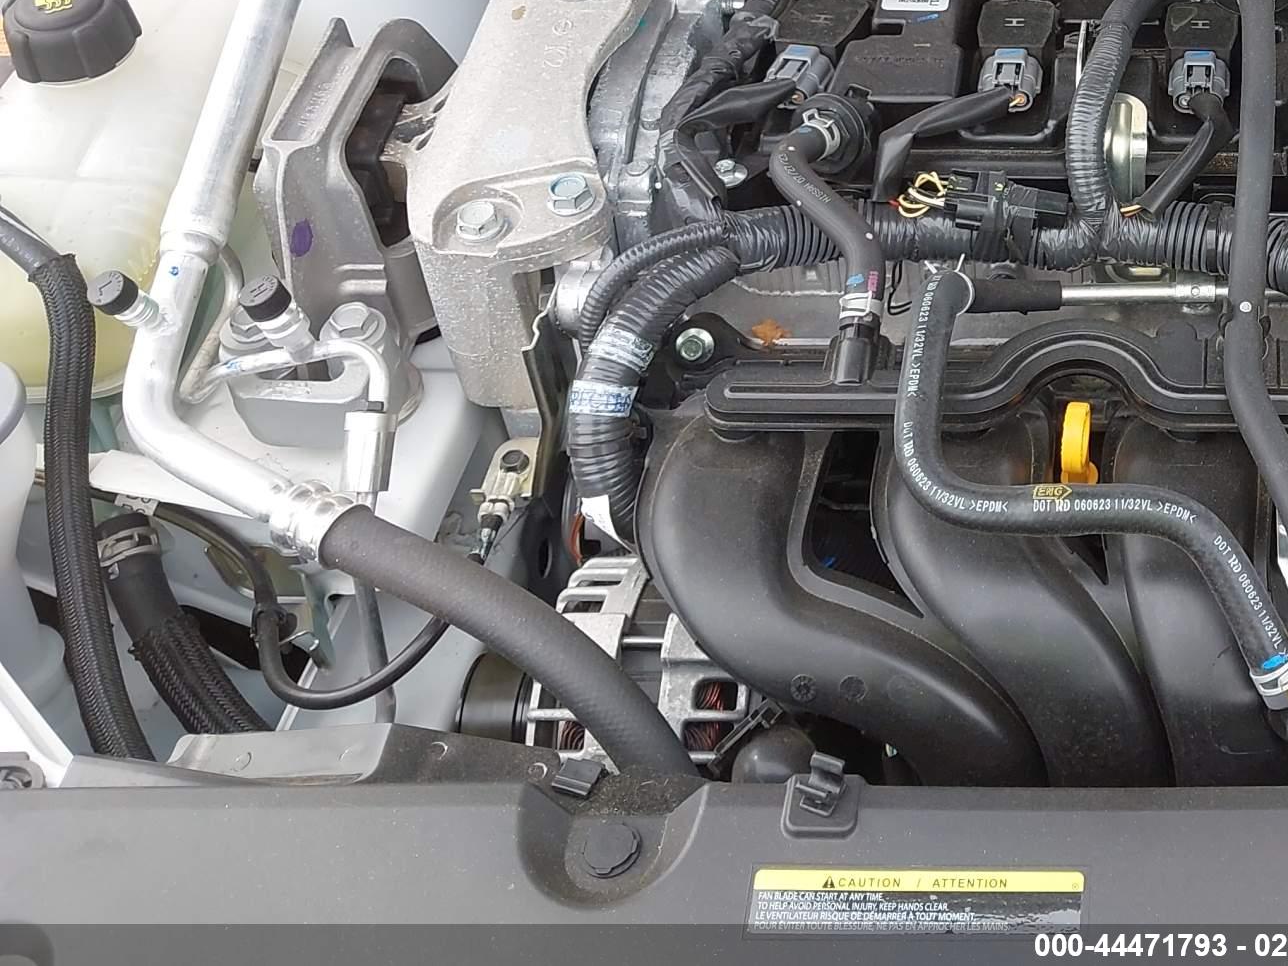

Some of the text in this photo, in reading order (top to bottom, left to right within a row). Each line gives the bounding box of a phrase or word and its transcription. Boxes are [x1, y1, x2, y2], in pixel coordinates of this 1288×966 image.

[907, 457, 932, 491] 060623
[968, 498, 1009, 514] >EPDM<
[1037, 486, 1064, 498] ENG
[1032, 499, 1050, 512] DOT
[1074, 498, 1112, 512] 060623
[1156, 500, 1198, 524] >EPDM<
[1214, 535, 1232, 556] DOT
[1238, 573, 1264, 610] 060623
[838, 878, 902, 888] CAUTION
[932, 878, 1008, 888] ATTENTION
[756, 912, 766, 920] LE
[766, 912, 818, 920] VENTILATEUR
[820, 912, 850, 920] RISQUE
[916, 912, 938, 920] TOUT
[754, 922, 778, 930] POUR
[806, 922, 832, 930] TOUTE
[876, 922, 888, 930] NE
[889, 922, 902, 930] PAS
[905, 922, 916, 930] EN
[916, 922, 966, 930] APPROCHER
[966, 922, 981, 930] LES
